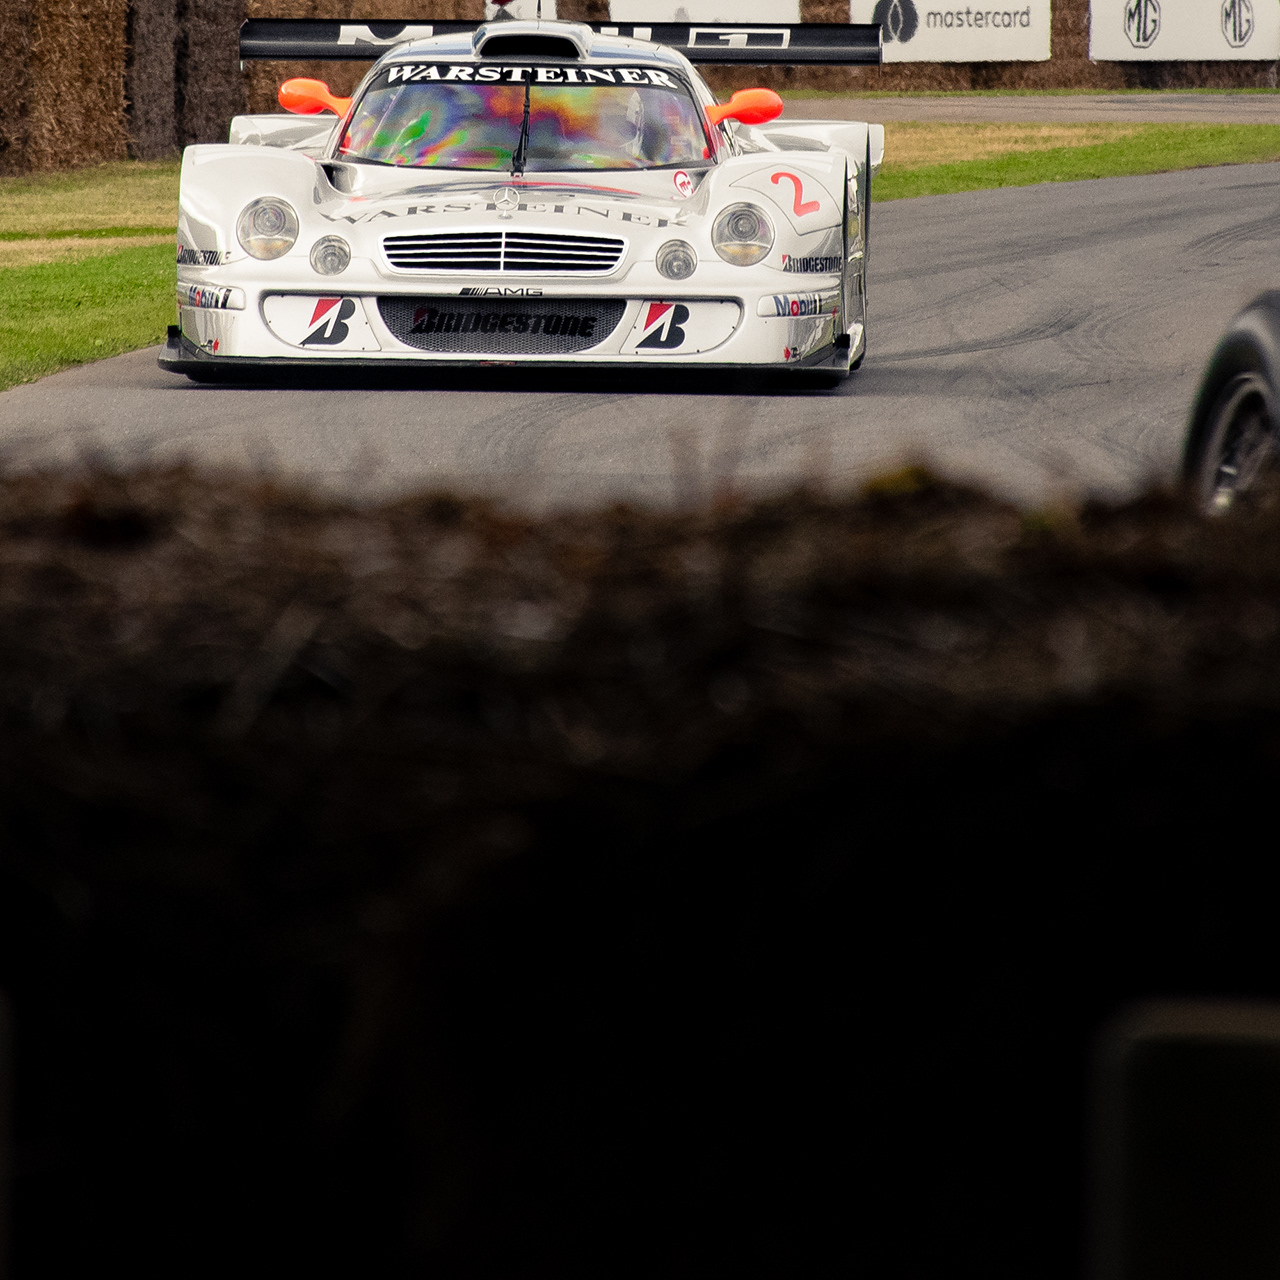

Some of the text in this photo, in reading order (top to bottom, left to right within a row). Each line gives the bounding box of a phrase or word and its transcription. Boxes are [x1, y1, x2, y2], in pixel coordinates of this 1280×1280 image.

[926, 5, 1031, 29] mastercard
[387, 64, 679, 89] WARSTEINER
[771, 171, 820, 218] 2
[782, 253, 843, 273] BRIDGESTONE
[483, 286, 544, 297] AMG
[409, 306, 599, 338] BRIDGESTONE
